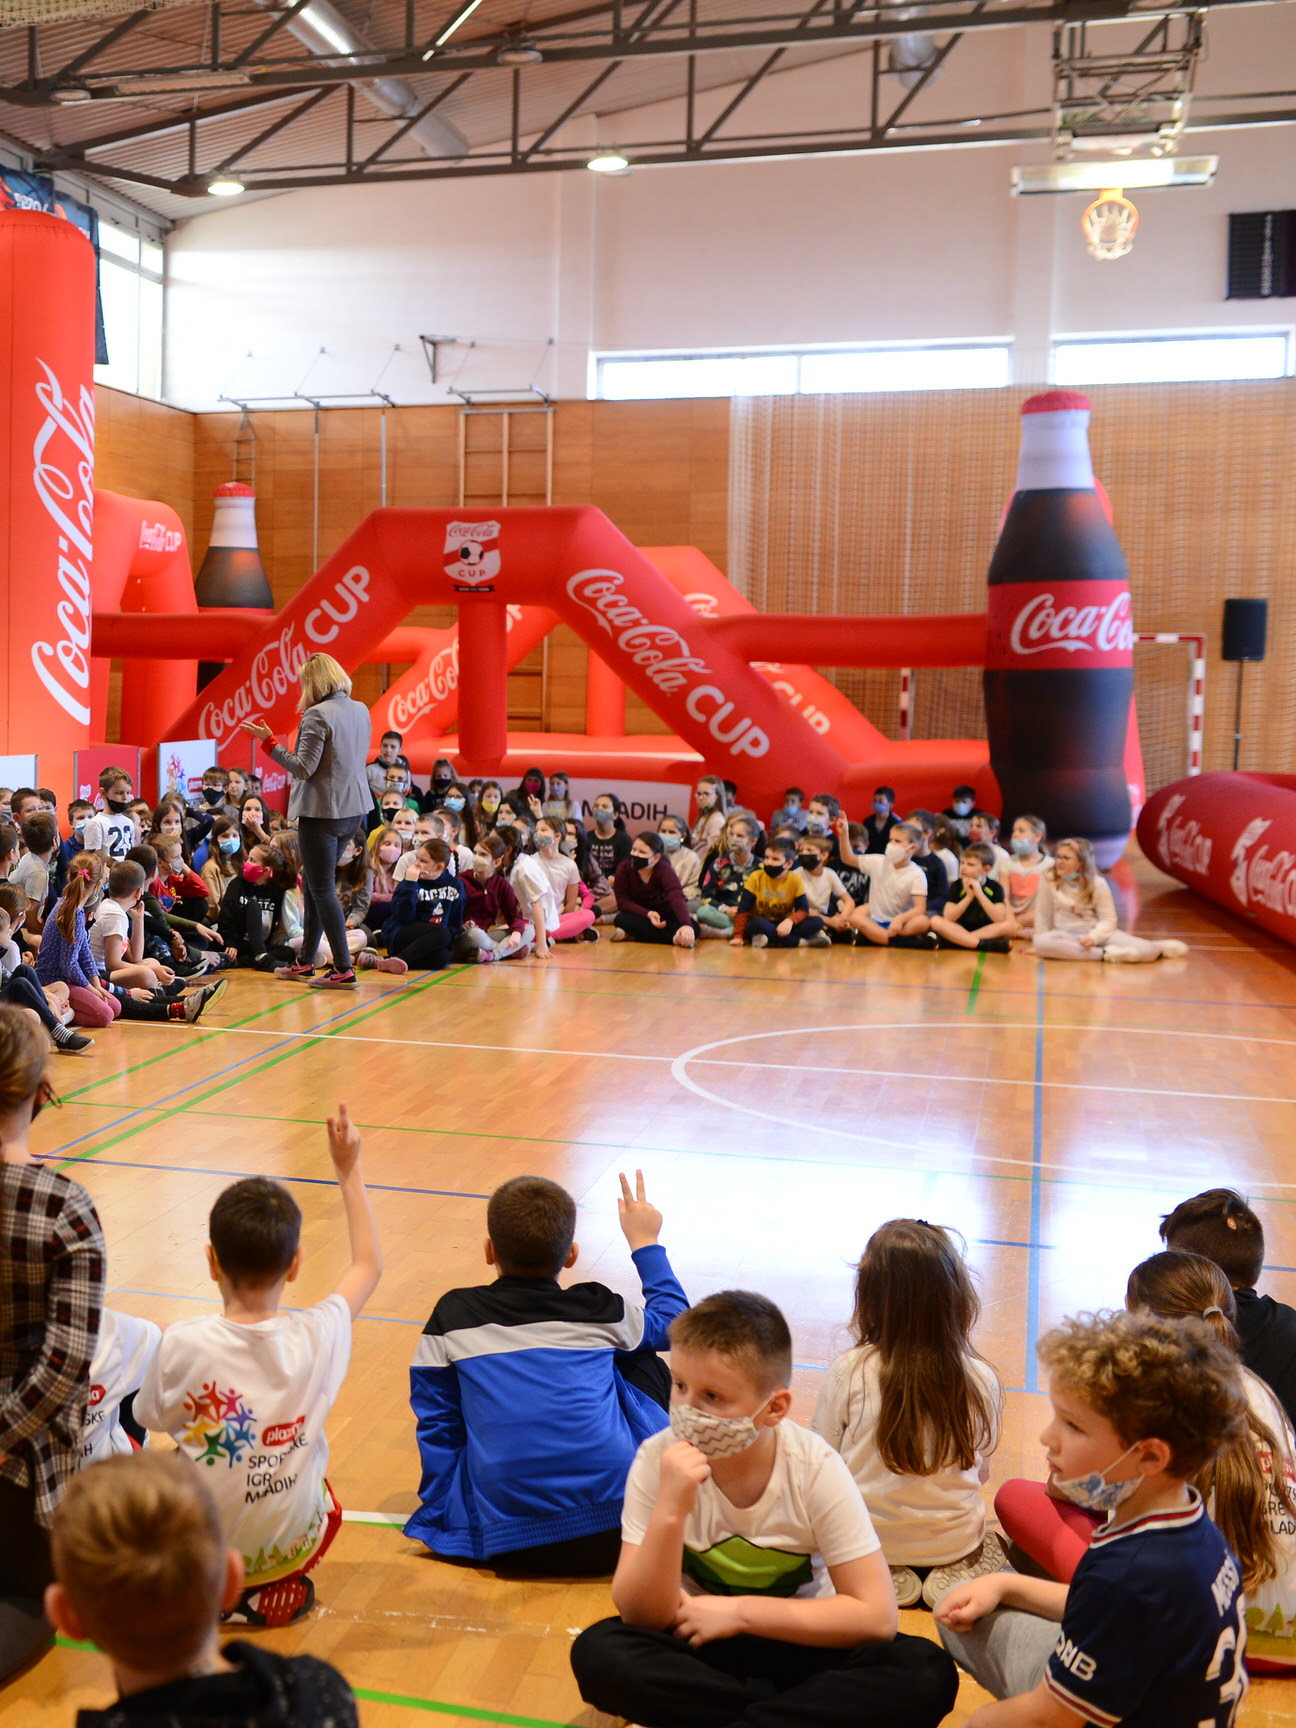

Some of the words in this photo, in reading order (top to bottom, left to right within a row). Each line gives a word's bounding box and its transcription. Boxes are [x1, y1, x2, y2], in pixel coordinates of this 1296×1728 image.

[31, 357, 95, 727] Coca-Cola
[304, 565, 371, 644] CUP
[458, 569, 486, 577] CUP
[566, 568, 712, 693] Coca-Cola
[686, 685, 770, 758] CUP
